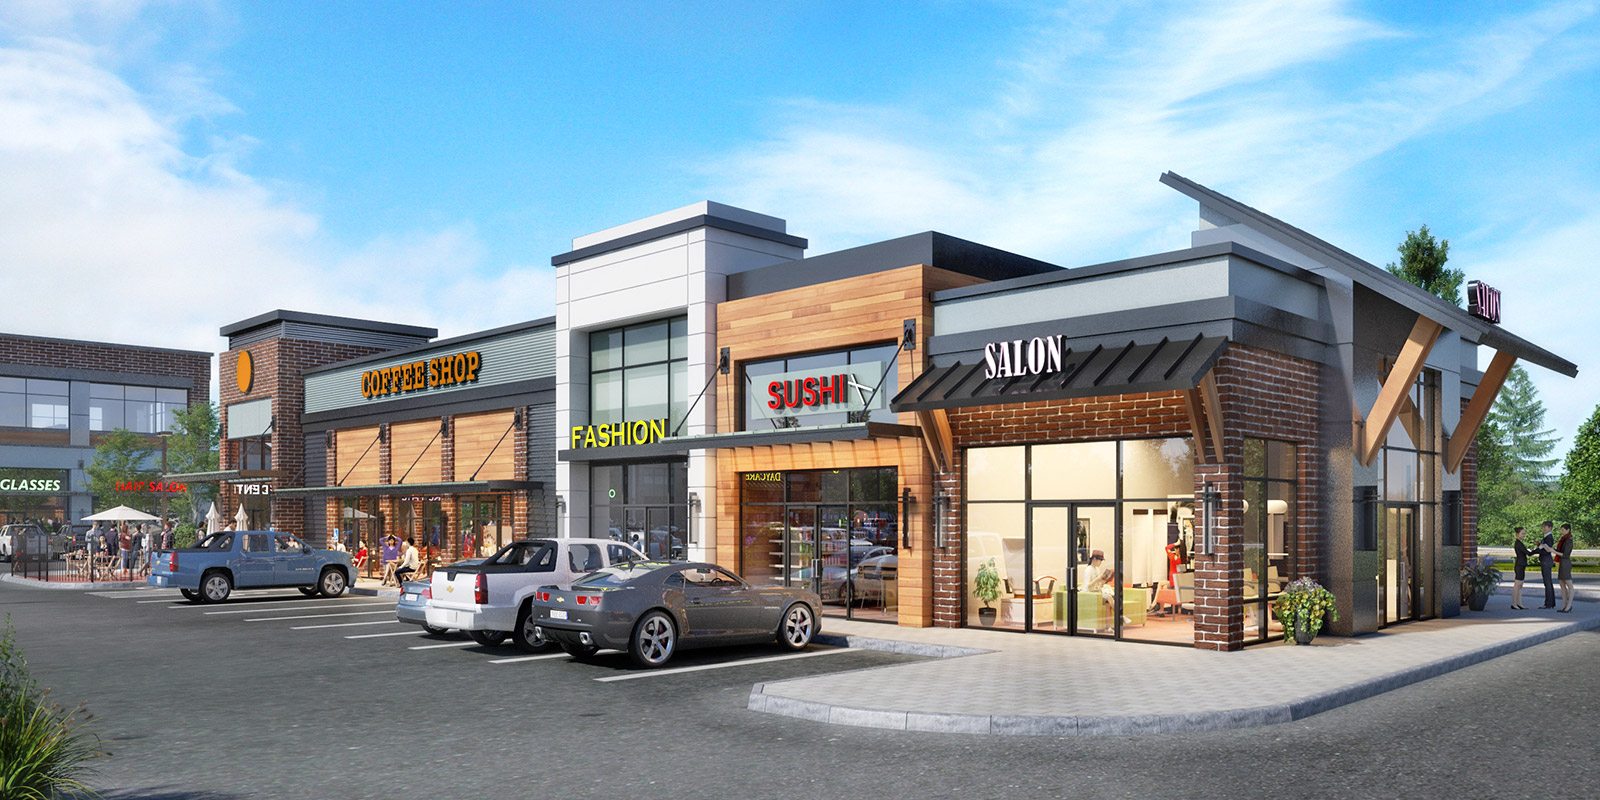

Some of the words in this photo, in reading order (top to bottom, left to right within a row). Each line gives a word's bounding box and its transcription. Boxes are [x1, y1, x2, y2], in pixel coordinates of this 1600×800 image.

[361, 360, 426, 399] COFFEE
[428, 351, 480, 388] SHOP
[984, 334, 1063, 380] SALON
[767, 373, 847, 410] SUSHI
[571, 418, 665, 449] FASHION
[0, 478, 61, 491] GLASSES
